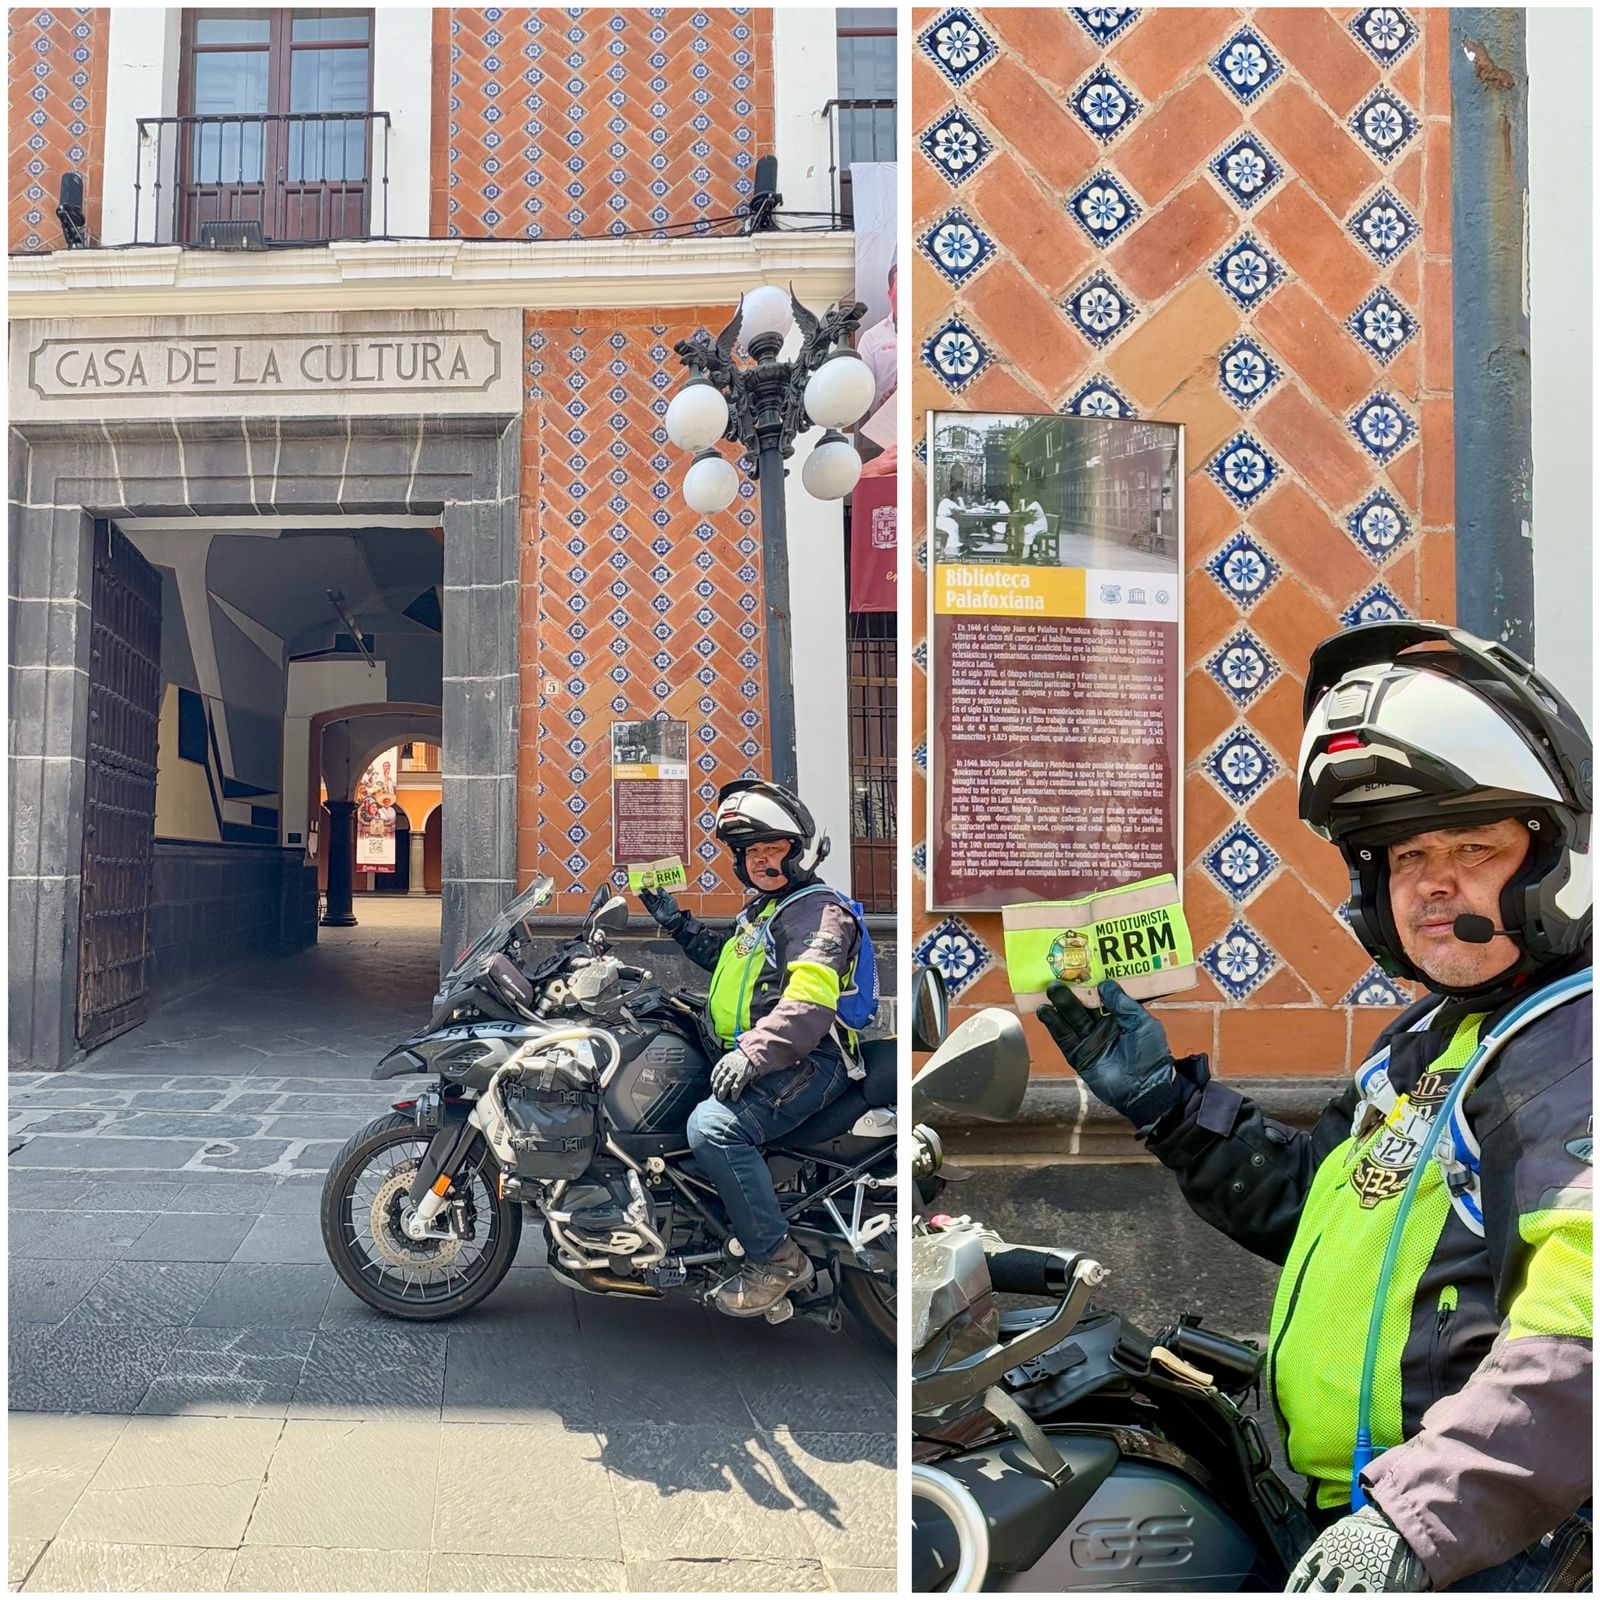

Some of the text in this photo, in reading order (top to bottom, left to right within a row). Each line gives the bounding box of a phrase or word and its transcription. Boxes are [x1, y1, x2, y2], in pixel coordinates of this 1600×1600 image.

[55, 342, 472, 388] CASA DE LA CULTURA
[946, 568, 1030, 588] Biblioteca
[946, 590, 1045, 610] Palafoxiana
[548, 682, 556, 692] 5
[656, 870, 680, 882] RRM
[1096, 908, 1170, 938] MOTOTURISTA
[1098, 922, 1176, 965] RRM
[1104, 960, 1150, 980] MÉXICO
[1379, 1136, 1417, 1164] 121
[1362, 1167, 1398, 1195] 132
[1070, 1515, 1195, 1572] GS
